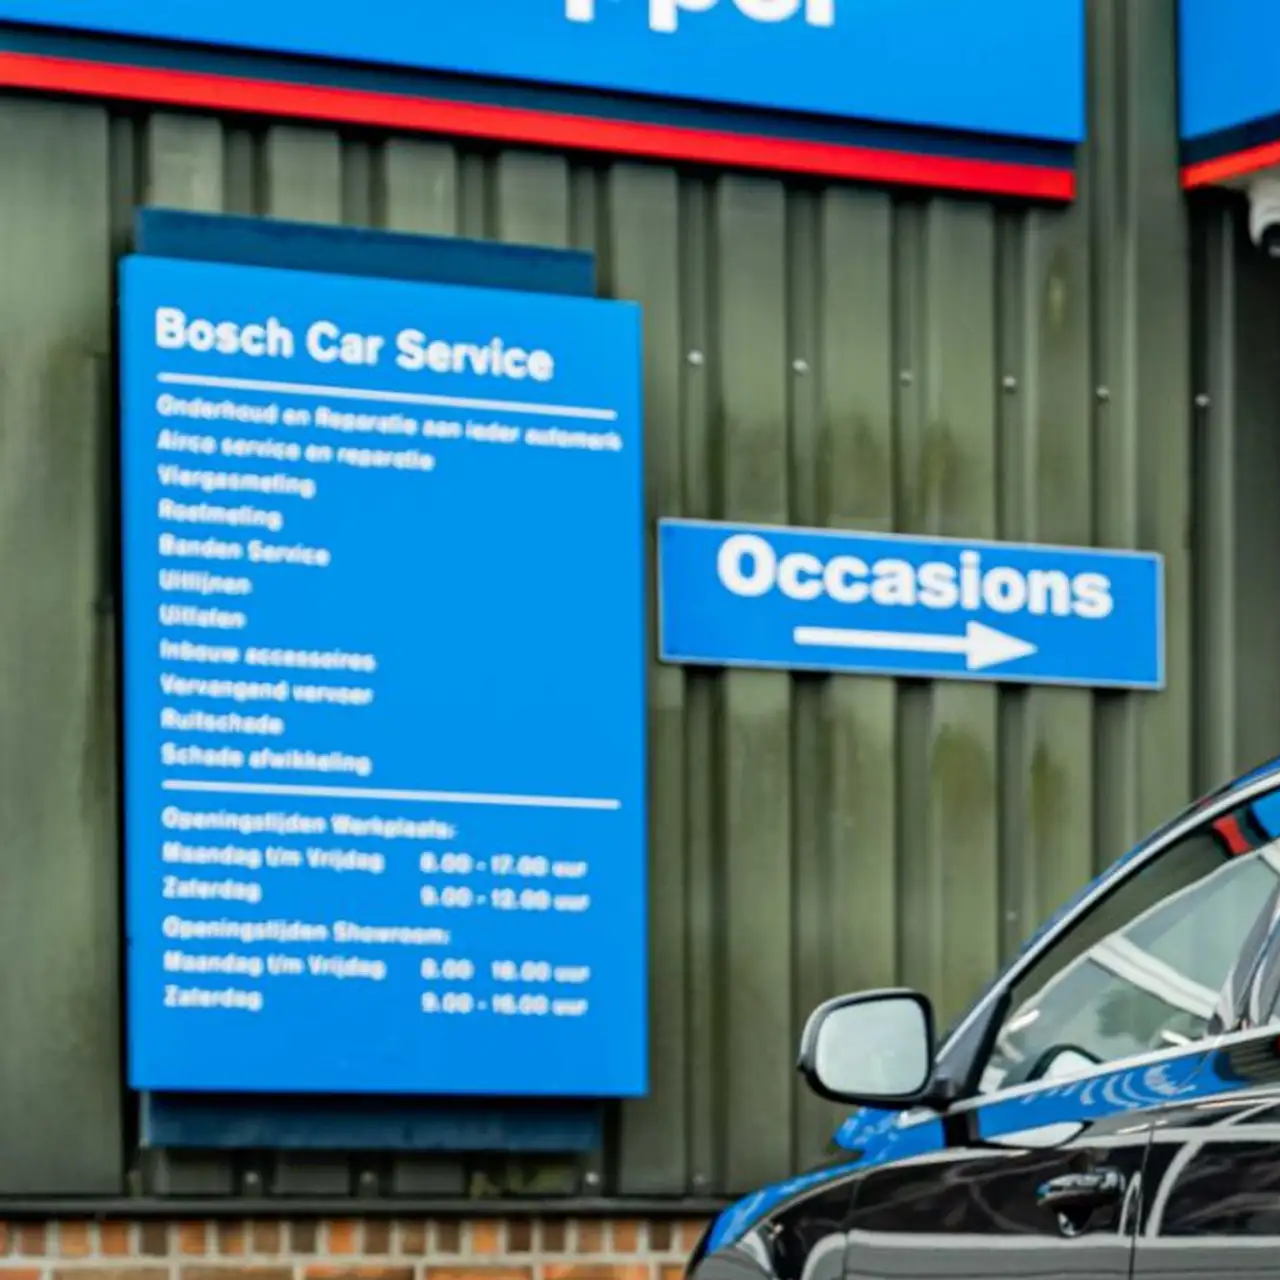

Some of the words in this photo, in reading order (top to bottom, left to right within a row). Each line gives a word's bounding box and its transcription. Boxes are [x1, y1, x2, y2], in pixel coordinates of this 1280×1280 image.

[156, 307, 294, 358] Bosch
[306, 321, 384, 365] Car
[396, 329, 553, 381] Service
[282, 409, 311, 425] en
[221, 438, 301, 460] service
[304, 445, 333, 462] en
[159, 533, 242, 559] Banden
[248, 540, 330, 566] Service
[716, 534, 1114, 620] Occasions
